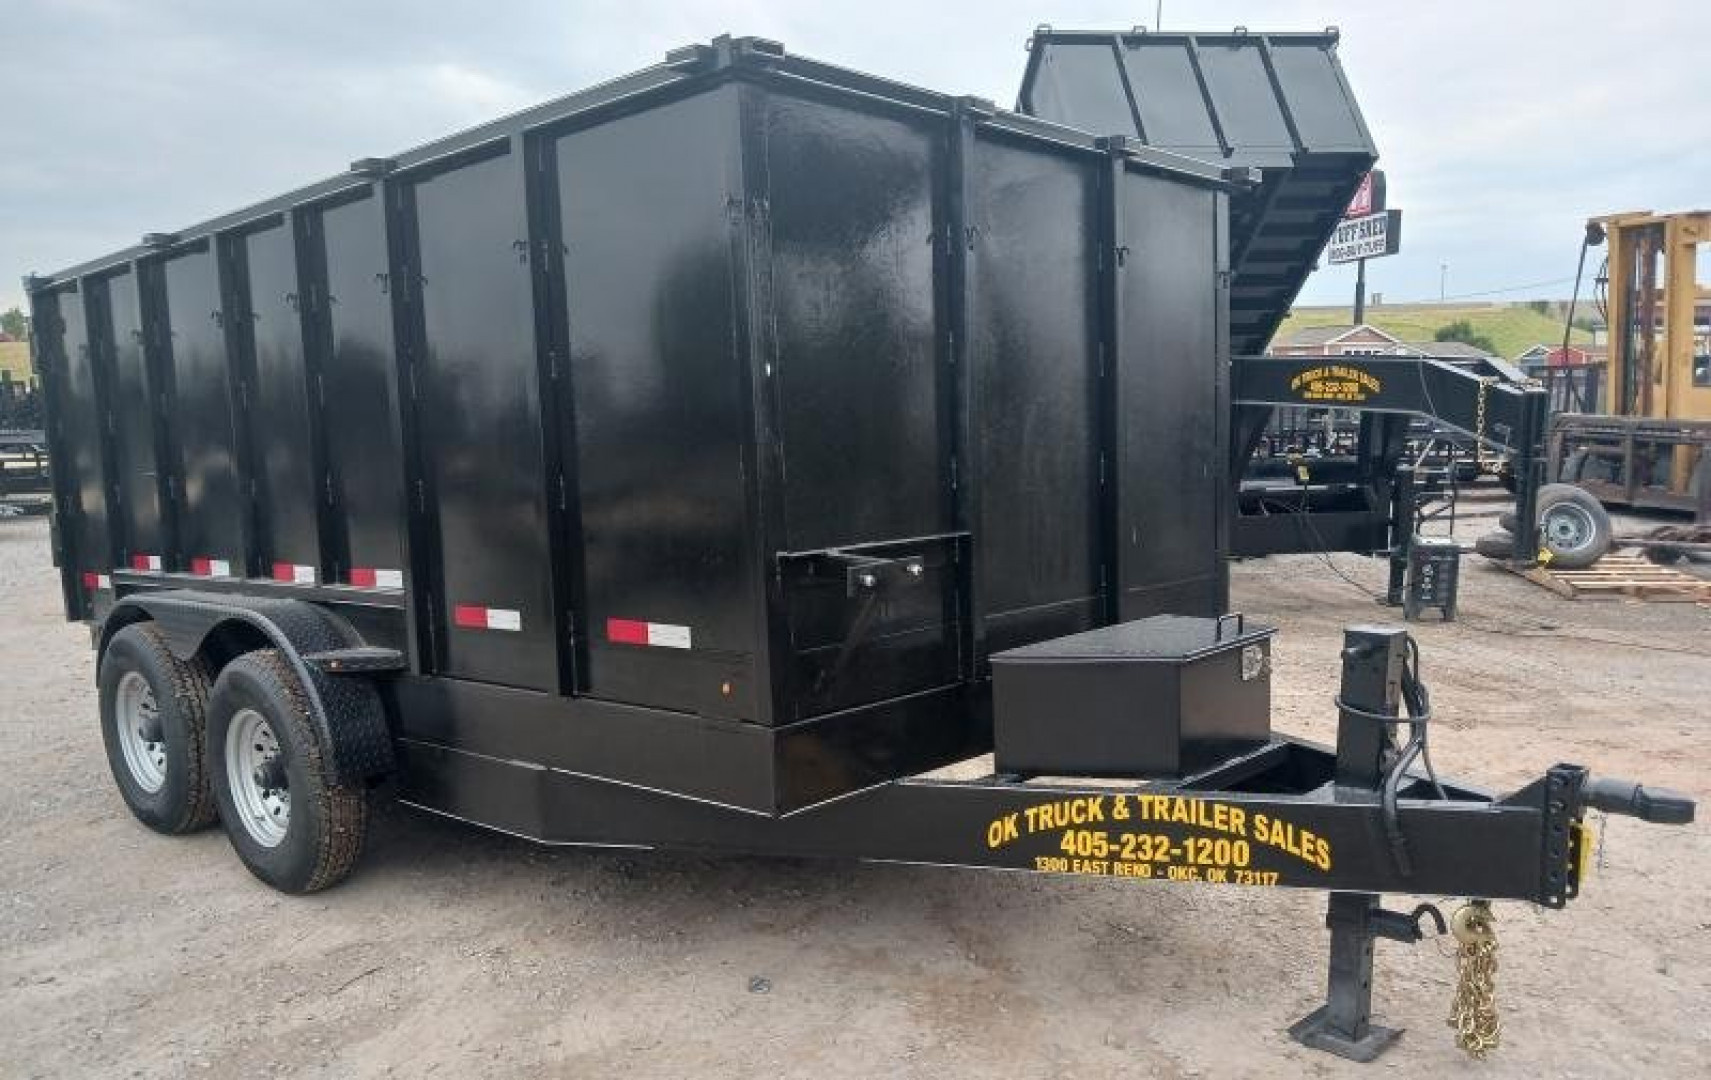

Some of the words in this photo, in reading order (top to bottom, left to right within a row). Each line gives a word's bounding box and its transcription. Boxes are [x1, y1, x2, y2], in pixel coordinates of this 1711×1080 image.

[987, 813, 1019, 848] OK
[1025, 797, 1104, 833] TRUCK
[1113, 795, 1130, 820] &
[1137, 794, 1247, 837] TRAILER
[1254, 814, 1332, 871] SALES
[1060, 828, 1250, 867] 405-232-1200
[1034, 856, 1068, 873] 1300
[1073, 858, 1108, 877] EAST
[1114, 859, 1152, 878] RENO
[1207, 867, 1228, 883] OK
[1233, 869, 1279, 887] 73117
